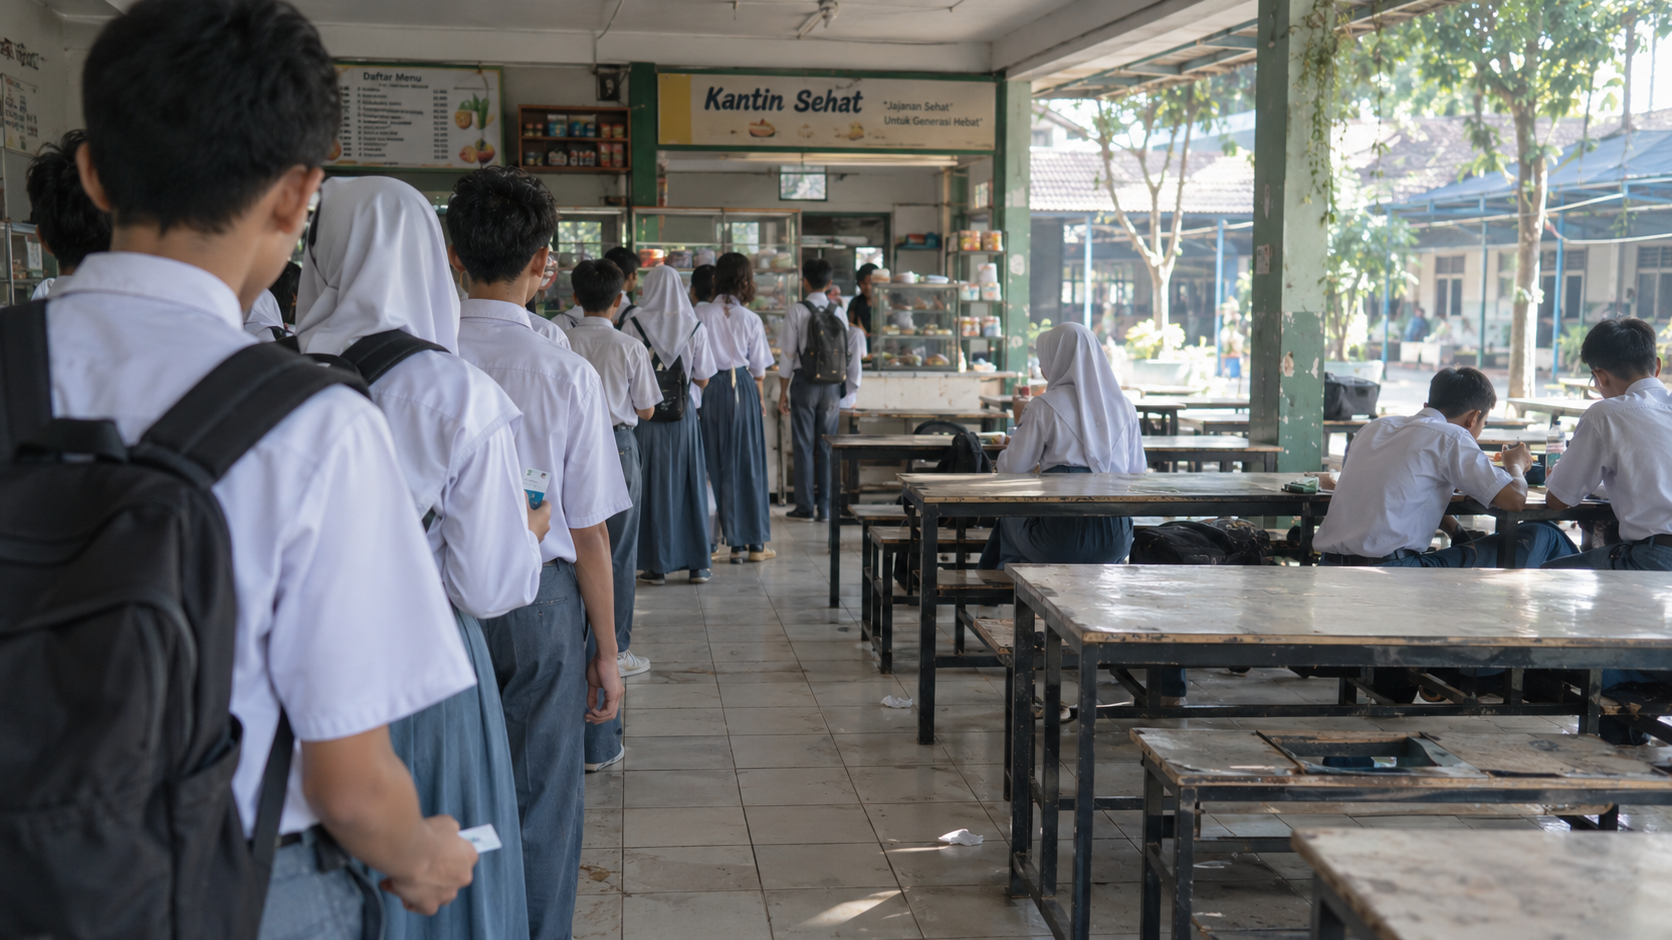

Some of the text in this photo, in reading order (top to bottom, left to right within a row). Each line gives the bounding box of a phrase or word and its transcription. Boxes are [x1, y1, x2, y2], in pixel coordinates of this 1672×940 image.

[363, 72, 422, 82] Daftar Menu
[704, 86, 864, 114] Kantin Sehat
[884, 116, 911, 125] Untuk
[913, 116, 951, 126] Generasi
